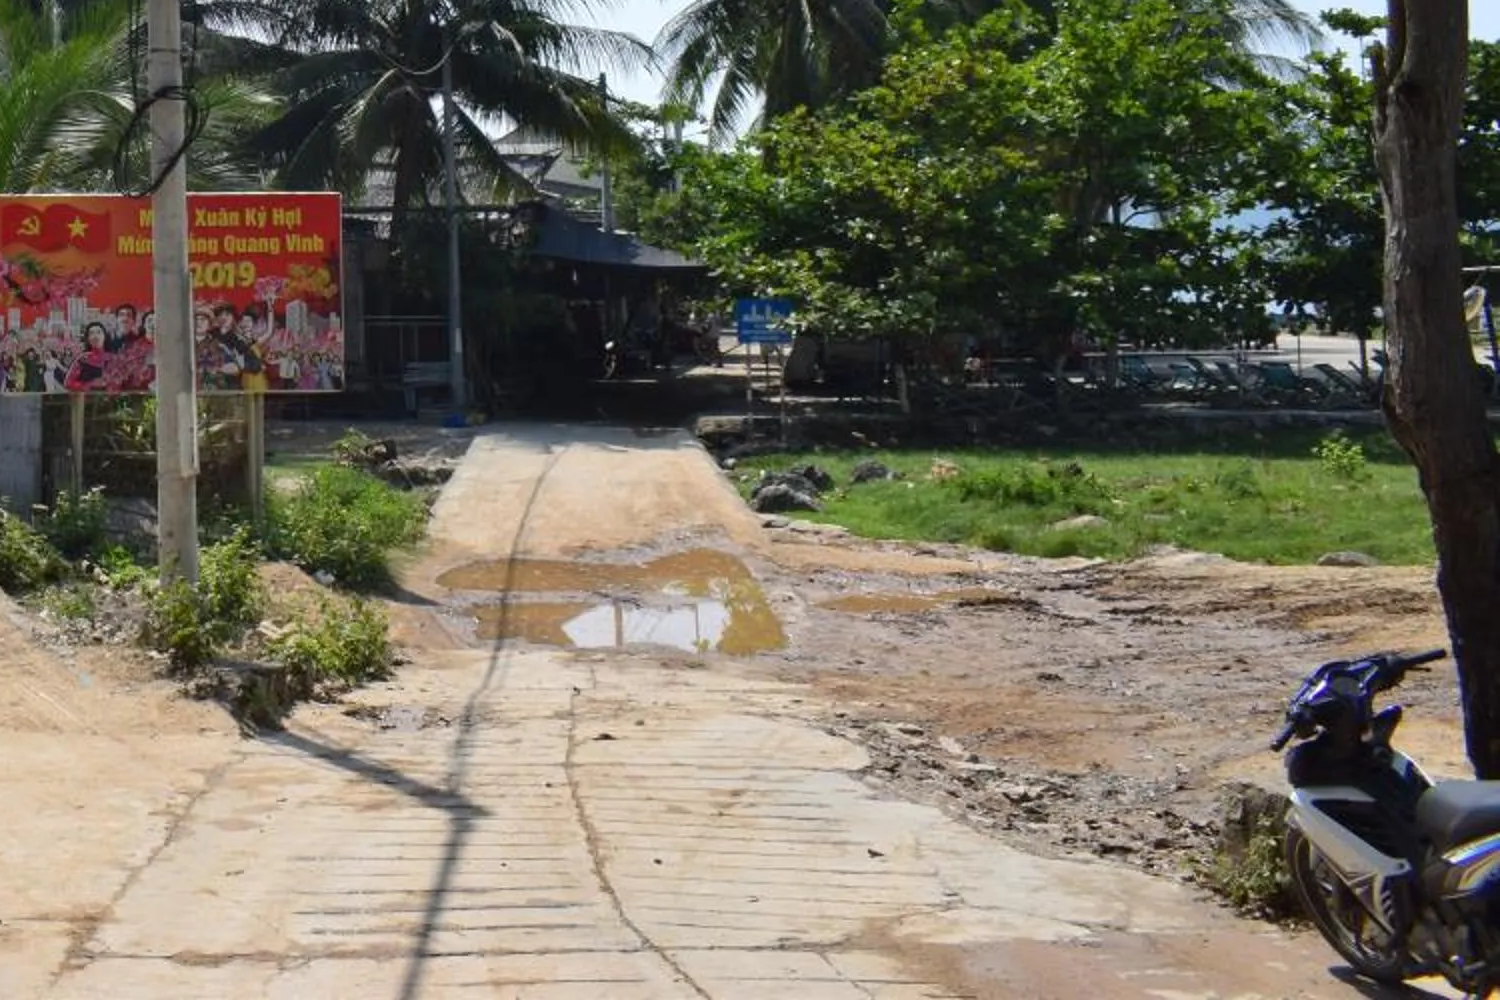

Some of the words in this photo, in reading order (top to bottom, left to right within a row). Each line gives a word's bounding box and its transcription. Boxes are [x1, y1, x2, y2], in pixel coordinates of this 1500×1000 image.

[223, 234, 280, 255] Quang
[285, 233, 325, 252] Vinh
[188, 261, 256, 288] 2019
